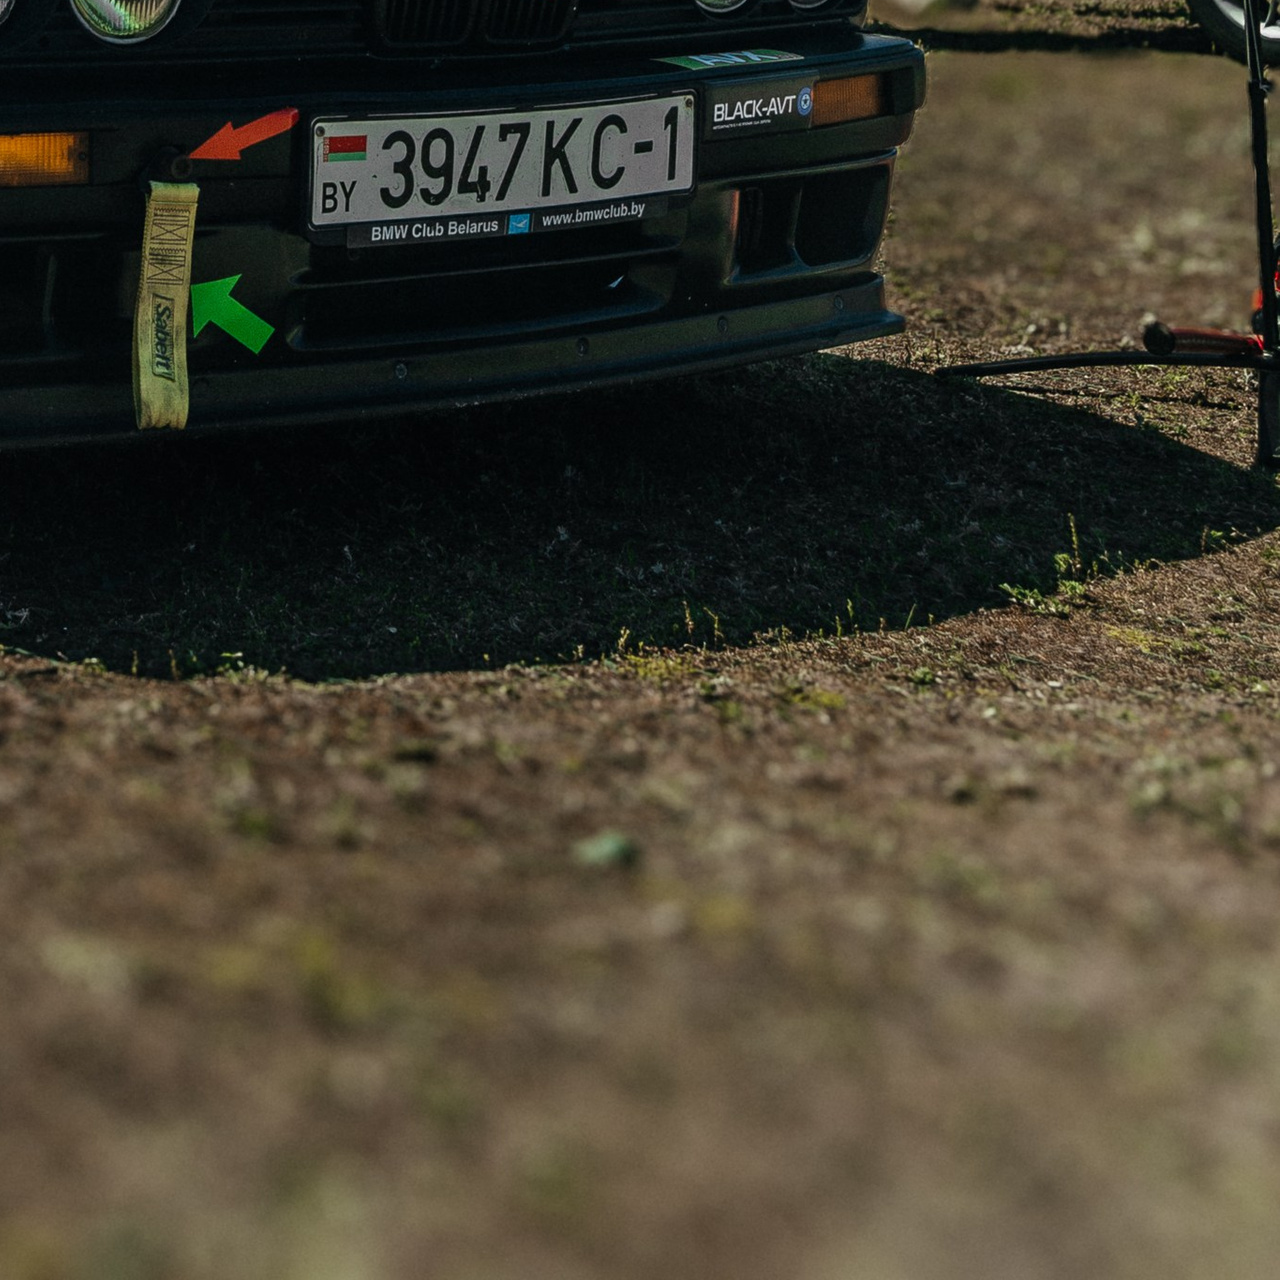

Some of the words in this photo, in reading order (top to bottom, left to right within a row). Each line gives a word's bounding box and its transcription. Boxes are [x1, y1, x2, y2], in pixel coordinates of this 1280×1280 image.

[713, 95, 797, 122] BLACK-AVT
[321, 180, 358, 214] BY
[542, 202, 646, 227] www.bmwclub.by
[371, 225, 409, 241] BMW
[411, 221, 444, 238] Club
[447, 219, 499, 236] Belarus
